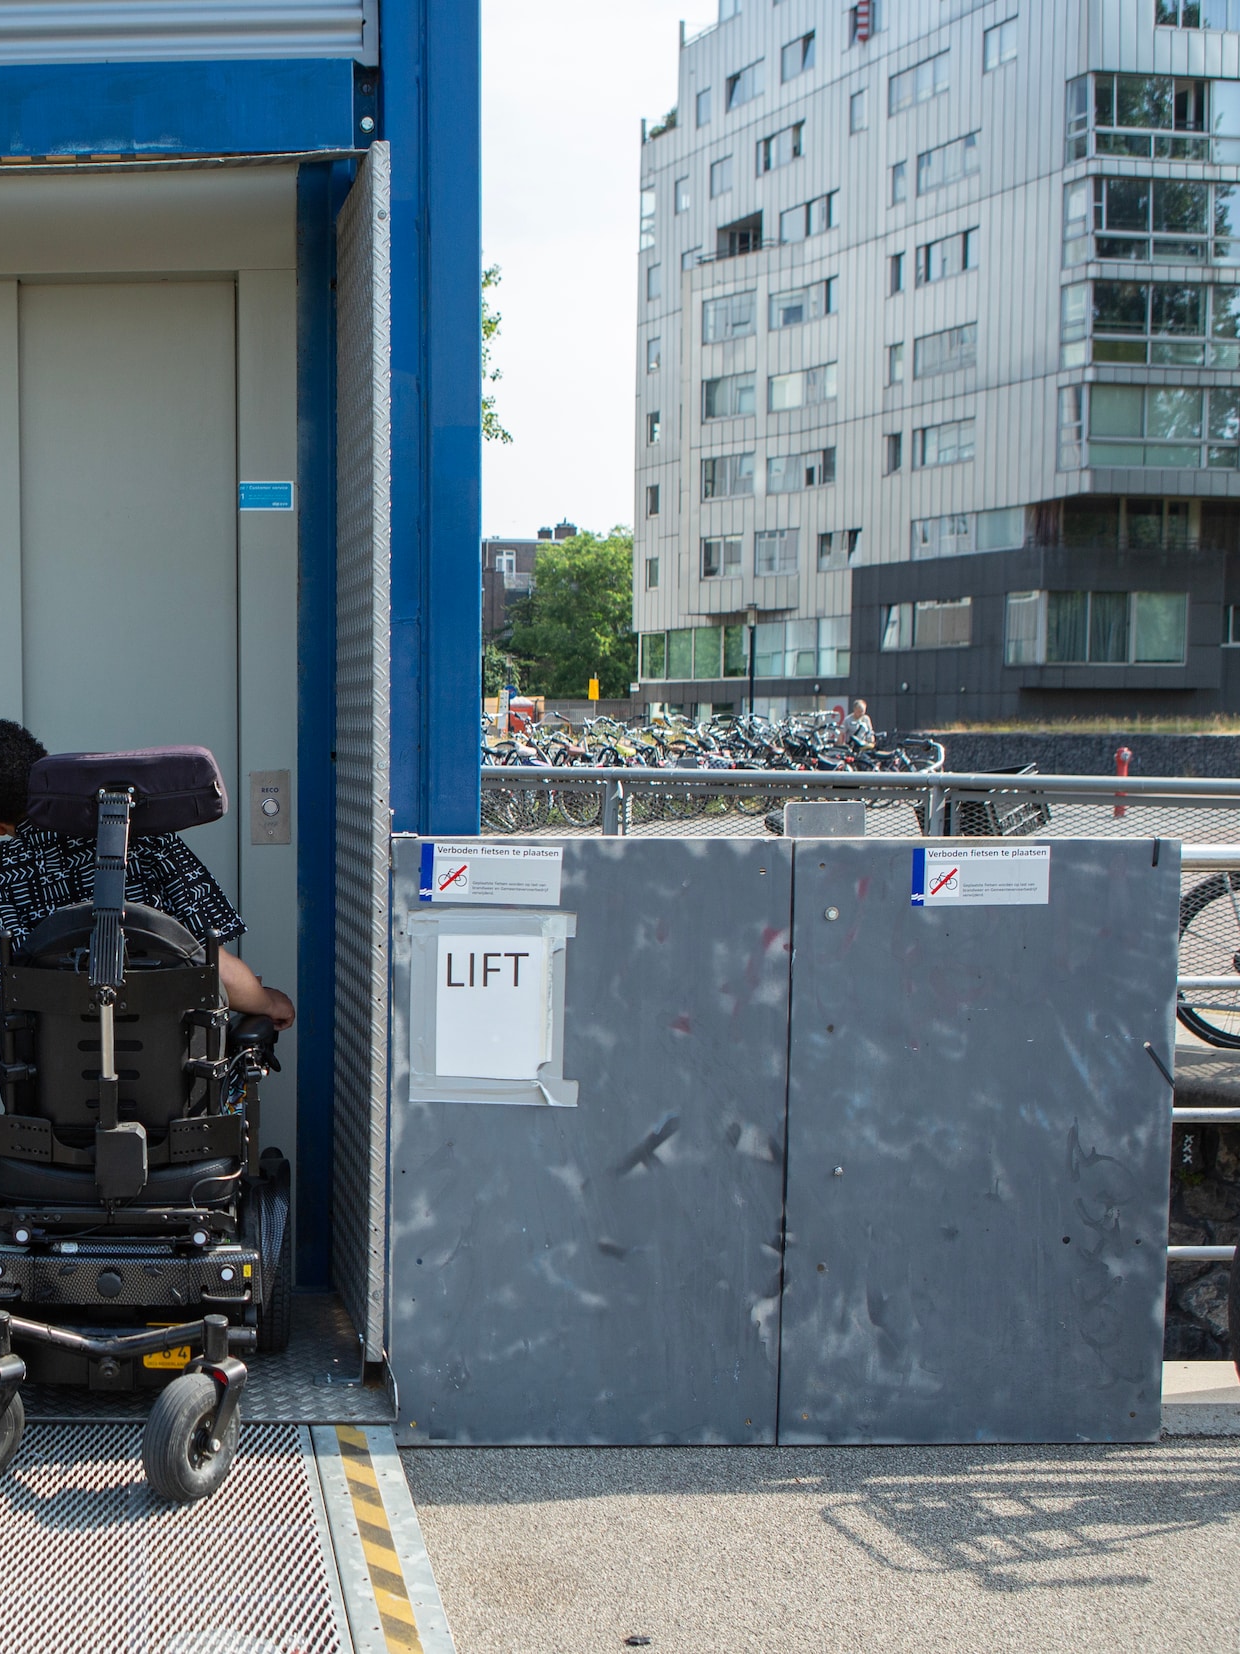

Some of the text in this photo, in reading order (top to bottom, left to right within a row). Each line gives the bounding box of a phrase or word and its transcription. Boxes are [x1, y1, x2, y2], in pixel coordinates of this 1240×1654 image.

[437, 846, 478, 855] Verboden
[481, 847, 510, 856] fietsen
[523, 849, 559, 858] plaatsen
[928, 848, 1047, 858] Verboden fietsen te plaatsen
[446, 953, 529, 987] LIFT
